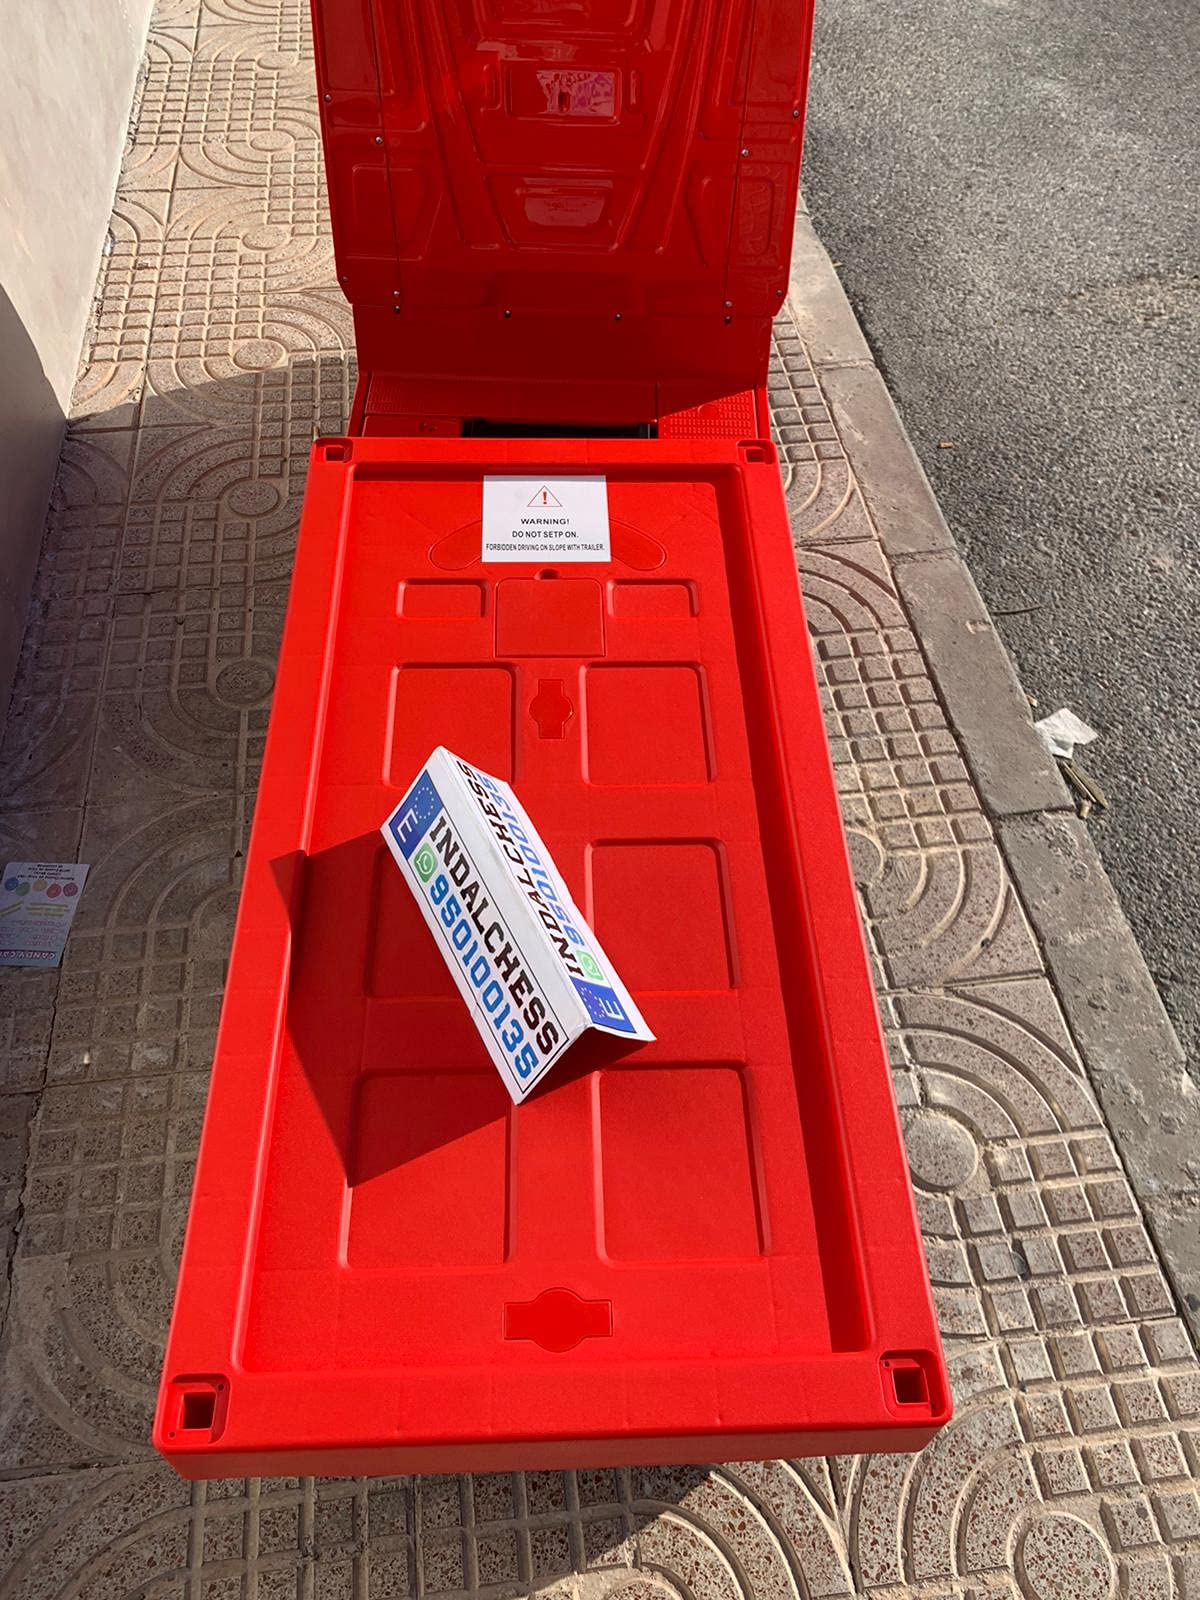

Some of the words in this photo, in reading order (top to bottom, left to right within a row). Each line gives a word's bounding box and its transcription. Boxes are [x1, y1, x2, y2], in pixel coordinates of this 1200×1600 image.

[486, 543, 517, 551] FORBIDDEN
[518, 543, 539, 551] DRIVING
[540, 543, 548, 551] ON
[549, 543, 566, 551] SLOPE
[512, 530, 524, 538] DO
[525, 530, 541, 538] NOT
[543, 530, 564, 538] SETP
[565, 530, 579, 538] ON.
[397, 809, 418, 843] E
[458, 761, 584, 978] INDALCHESS
[479, 773, 584, 946] 950100135
[428, 816, 559, 1056] INDALCHESS
[429, 874, 540, 1079] 950100135
